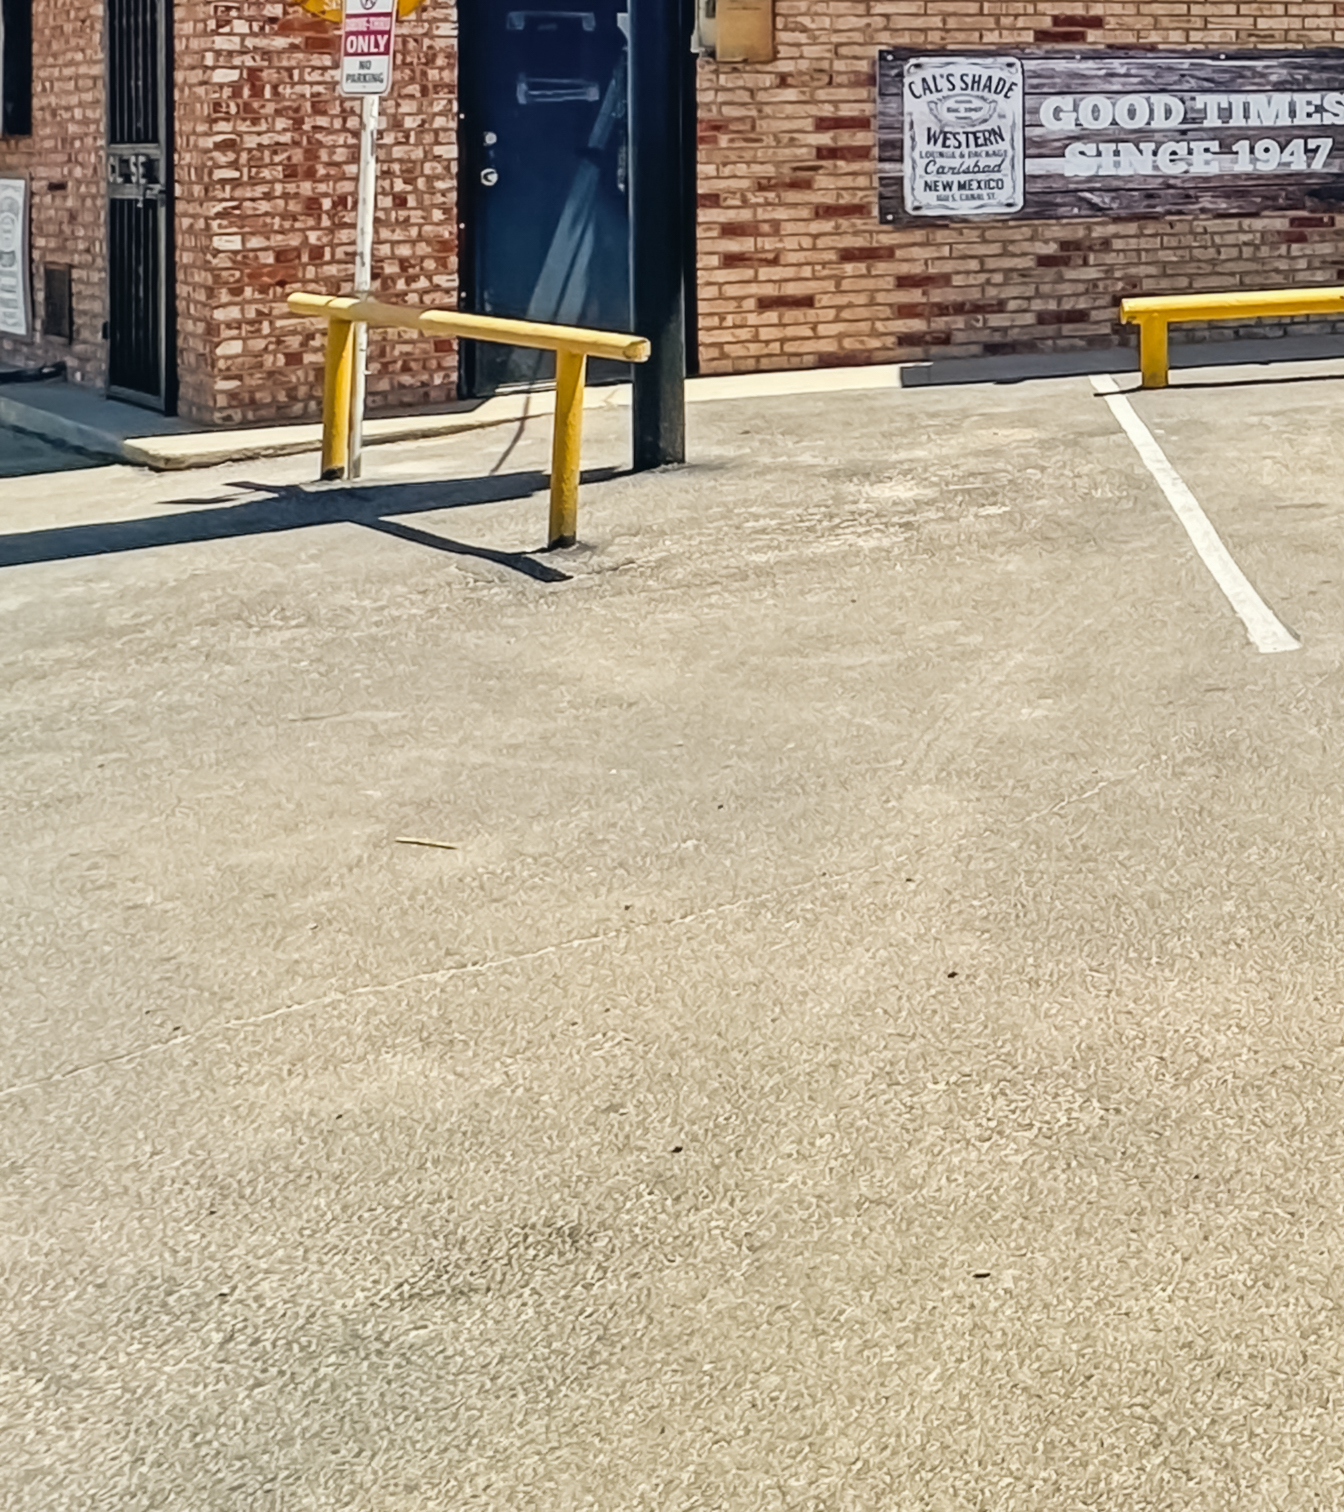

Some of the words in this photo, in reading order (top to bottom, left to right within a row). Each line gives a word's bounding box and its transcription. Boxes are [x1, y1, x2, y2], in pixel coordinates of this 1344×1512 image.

[346, 35, 389, 54] ONLY
[358, 60, 372, 71] NO
[908, 73, 956, 99] CAL'S
[959, 73, 1018, 99] SHADE
[1039, 94, 1185, 131] GOOD
[926, 124, 1006, 150] WESTERN
[923, 157, 1006, 176] Carlsbad
[1063, 140, 1221, 178] SINCE
[1231, 138, 1334, 172] 1947
[923, 179, 954, 192] NEW
[957, 178, 1005, 192] MEXICO
